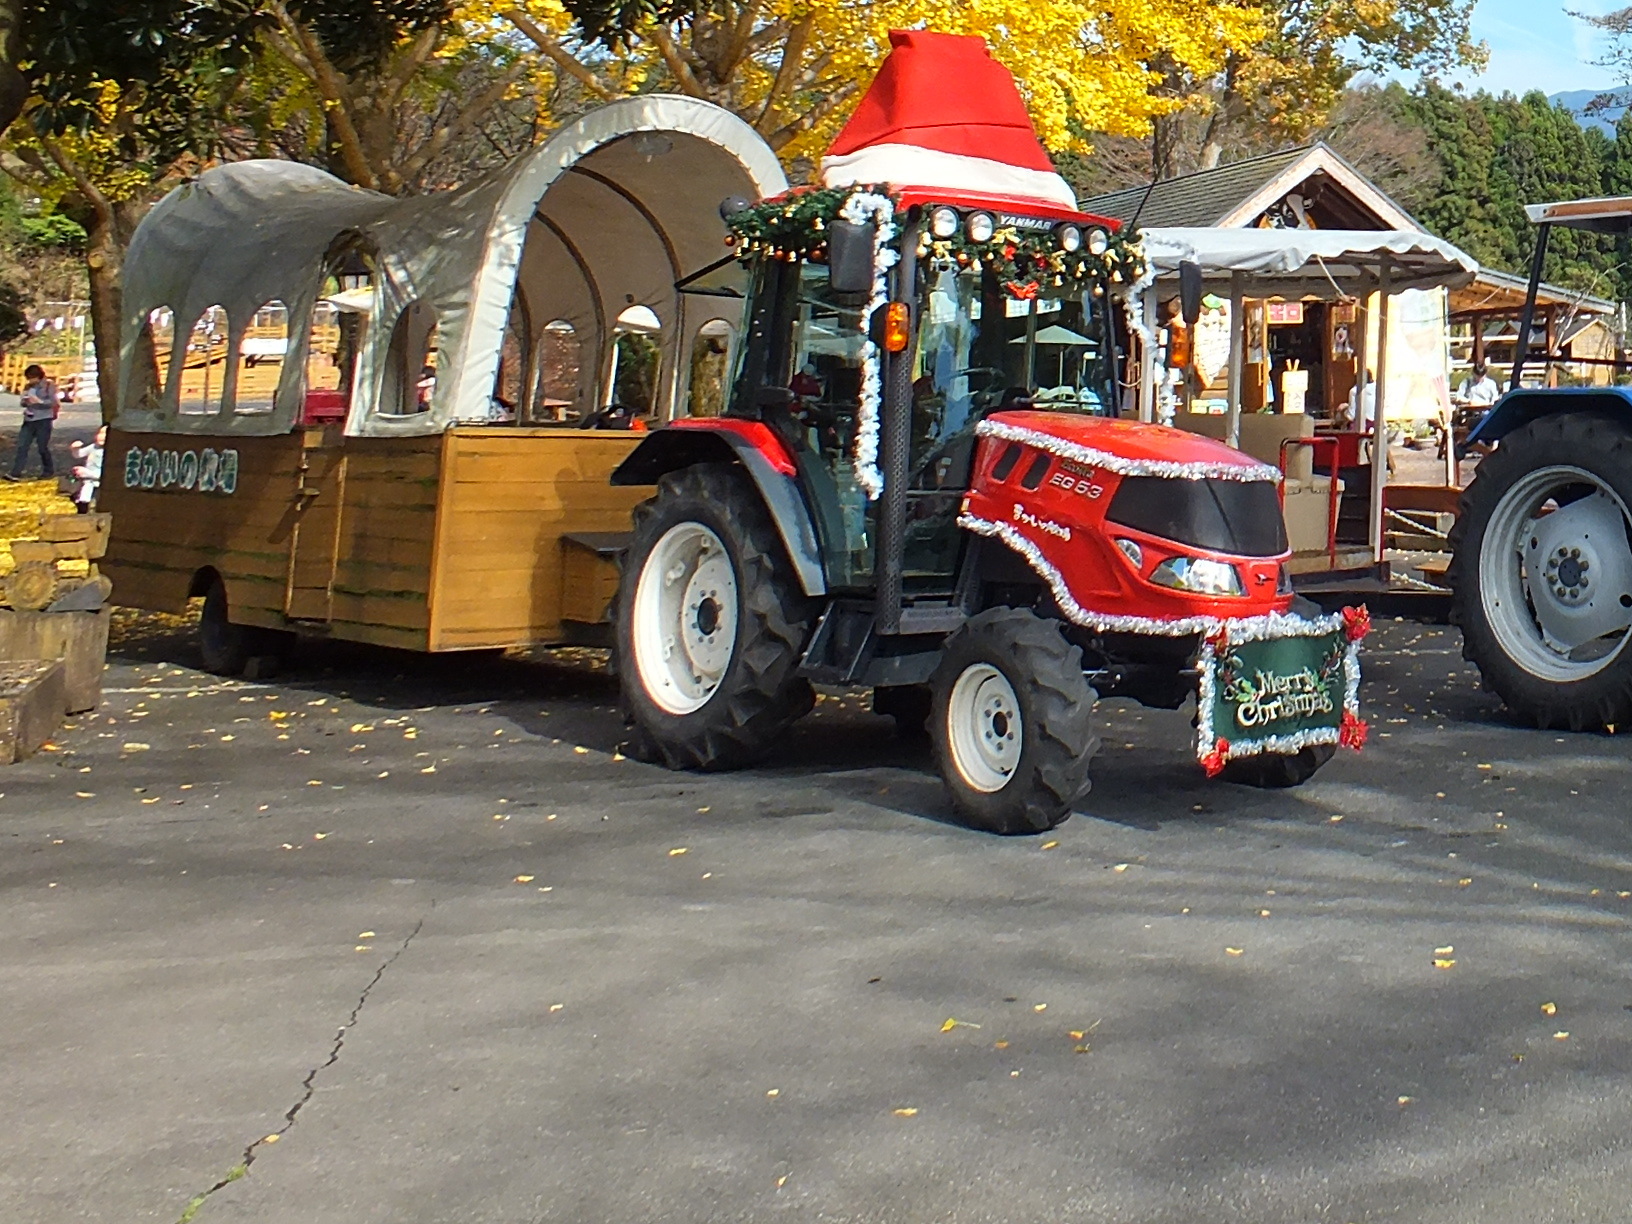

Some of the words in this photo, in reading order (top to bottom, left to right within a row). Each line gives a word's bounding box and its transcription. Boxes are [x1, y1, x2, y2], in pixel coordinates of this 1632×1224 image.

[1000, 215, 1052, 230] YANMAR
[1254, 666, 1315, 696] Merry
[1237, 692, 1334, 727] Christmas
